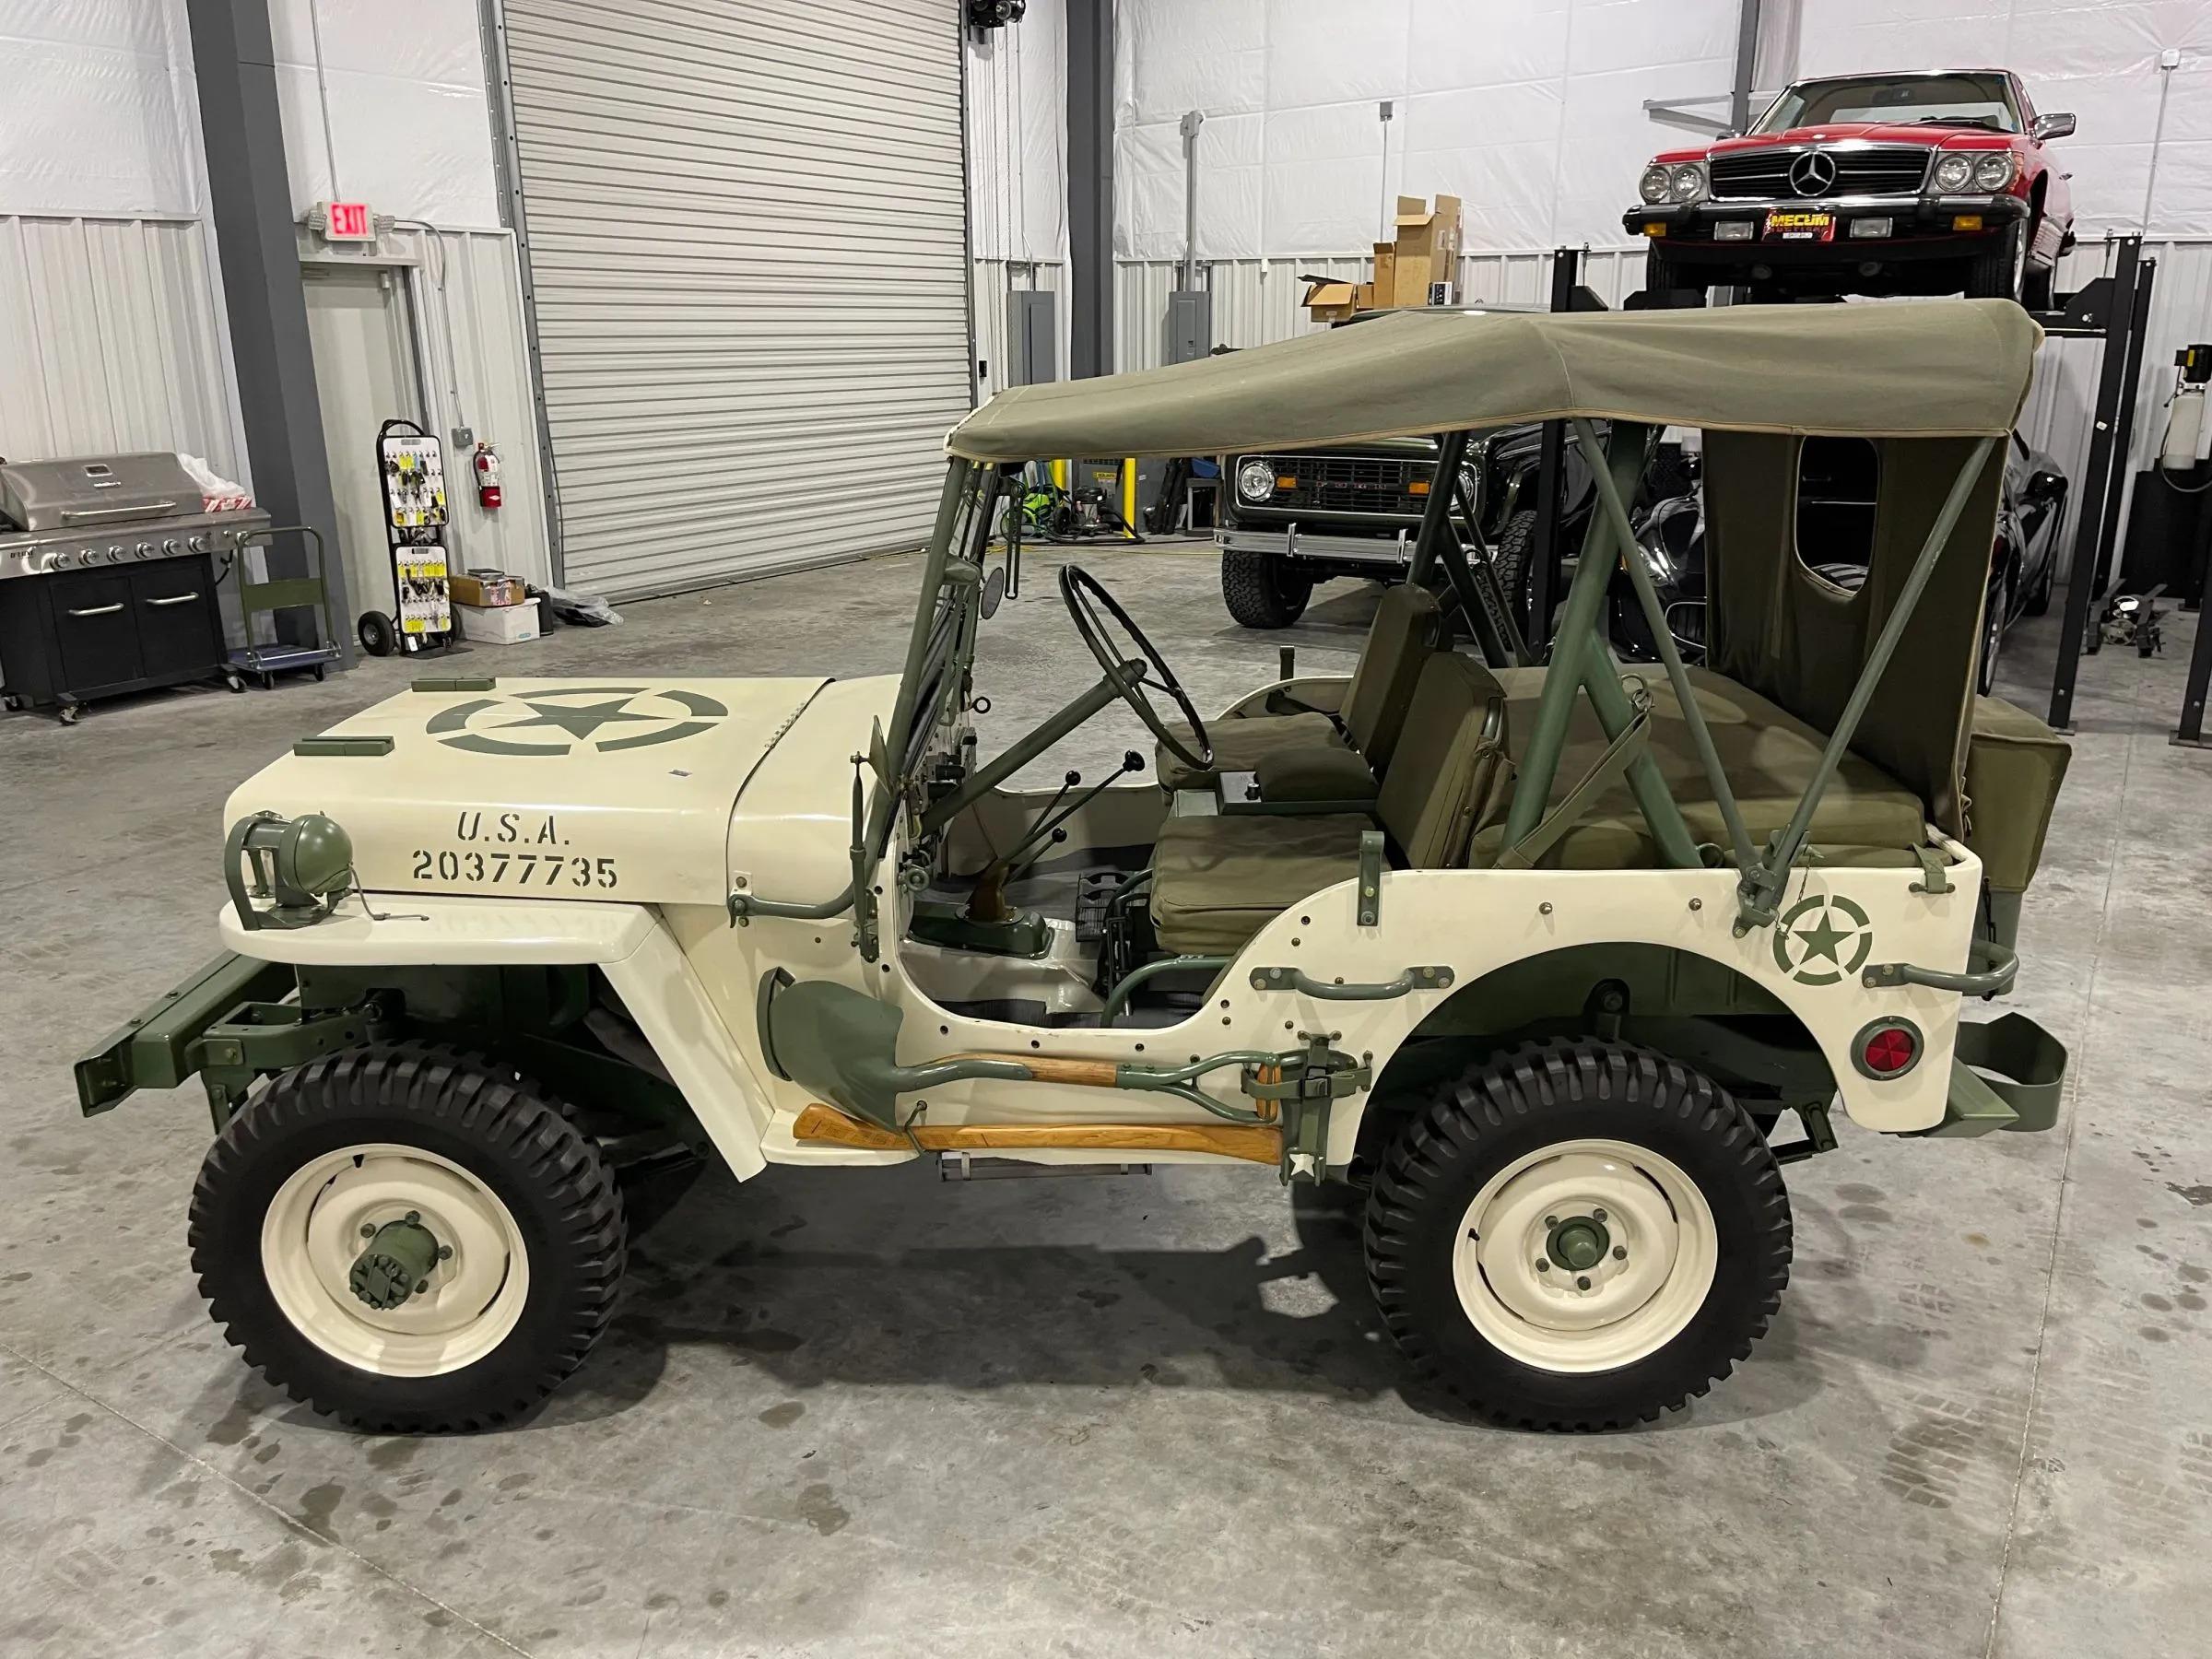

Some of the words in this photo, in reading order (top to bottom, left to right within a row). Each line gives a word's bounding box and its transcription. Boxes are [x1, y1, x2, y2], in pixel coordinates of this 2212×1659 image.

[331, 204, 366, 234] EXIT
[1771, 213, 1830, 227] MECUM
[457, 811, 570, 845] U.S.A.
[412, 849, 618, 888] 20377735
